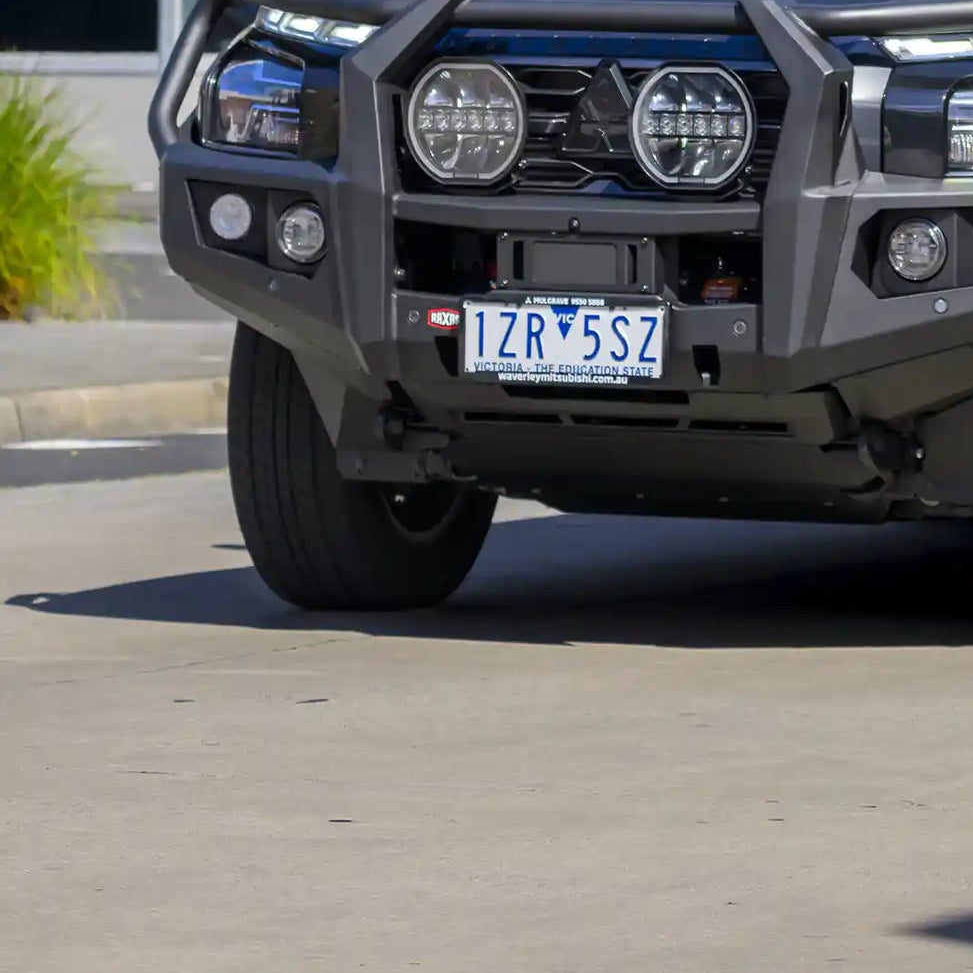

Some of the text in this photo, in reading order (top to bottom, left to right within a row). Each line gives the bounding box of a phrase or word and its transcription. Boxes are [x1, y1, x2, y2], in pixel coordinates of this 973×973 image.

[533, 296, 569, 305] MULGRAVE
[556, 313, 575, 324] VIC
[475, 311, 658, 363] 1ZR 5SZ
[474, 361, 524, 373] VICTORIA
[535, 363, 554, 374] THE
[558, 364, 619, 376] EDUCATION
[623, 366, 654, 377] STATE
[498, 372, 628, 384] waverleymitsubishi.com.au
